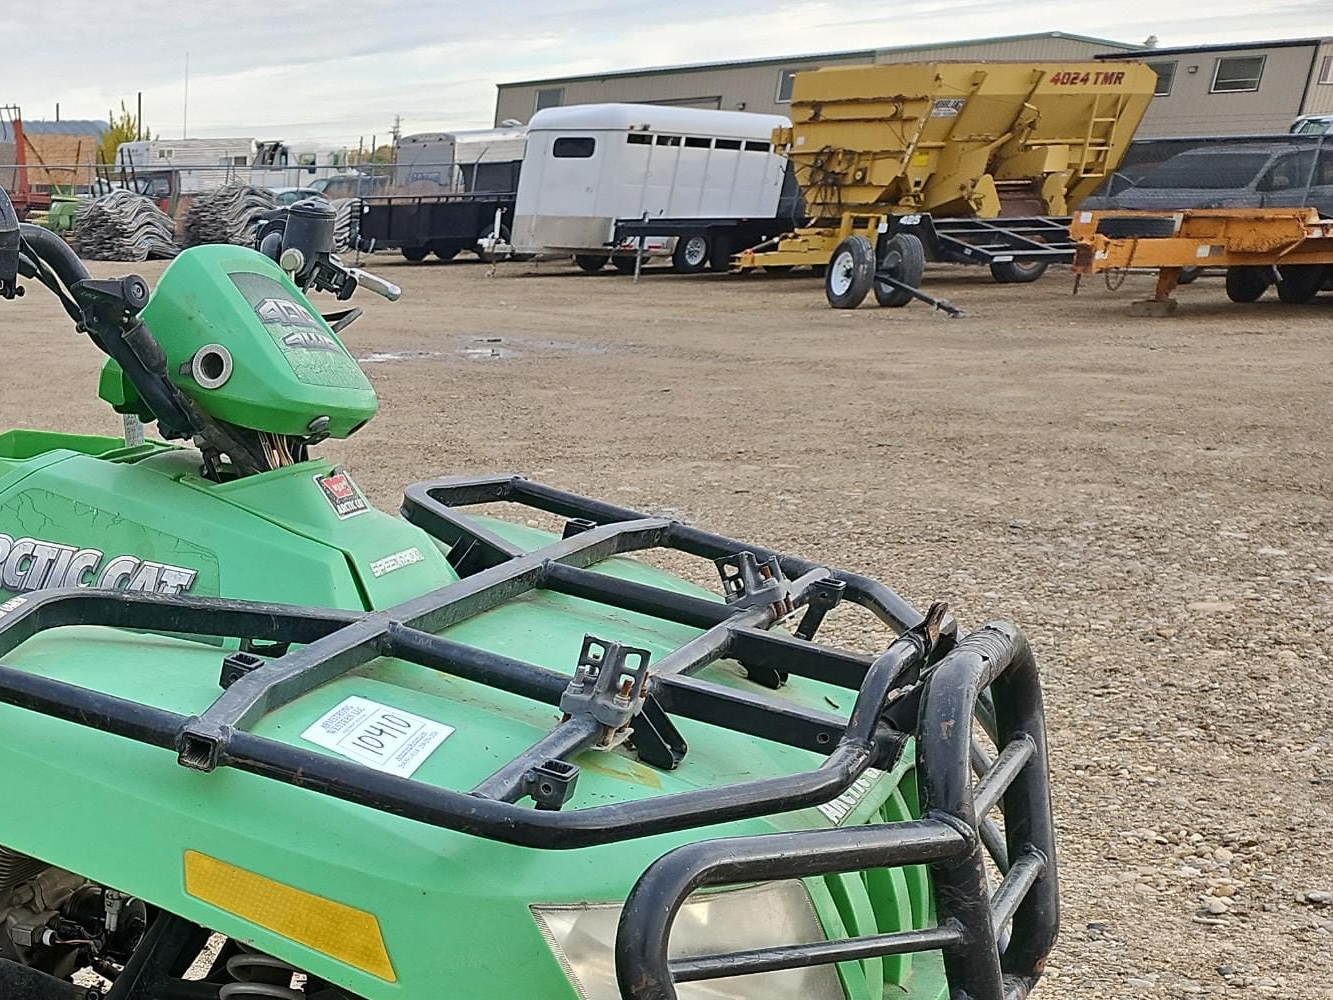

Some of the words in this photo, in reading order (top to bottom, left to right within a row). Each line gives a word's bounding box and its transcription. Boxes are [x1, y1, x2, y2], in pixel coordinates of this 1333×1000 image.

[1050, 71, 1089, 86] 4024
[1091, 71, 1126, 86] TMR
[253, 298, 323, 330] 400
[97, 555, 199, 596] CAT
[351, 713, 411, 756] 10410
